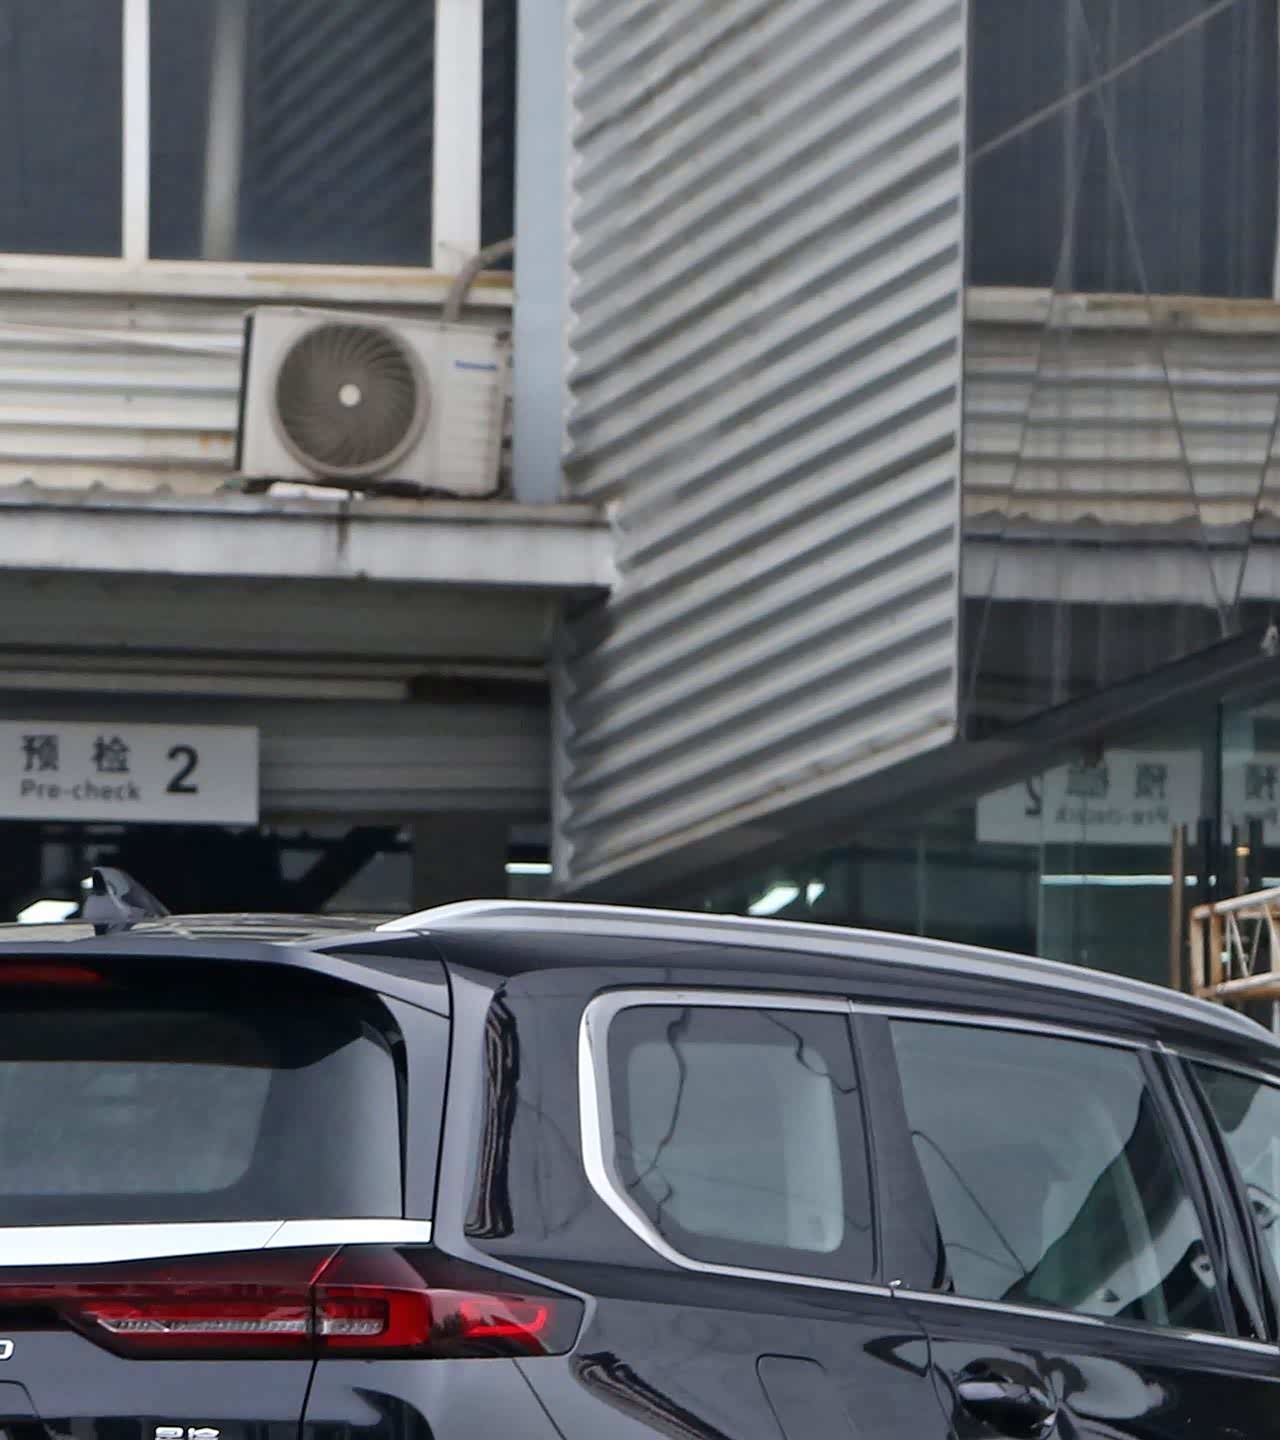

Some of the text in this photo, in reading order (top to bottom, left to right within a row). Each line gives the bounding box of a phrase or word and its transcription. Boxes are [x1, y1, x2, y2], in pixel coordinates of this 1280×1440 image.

[21, 734, 199, 794] 预检 2
[20, 778, 141, 801] Pre-check
